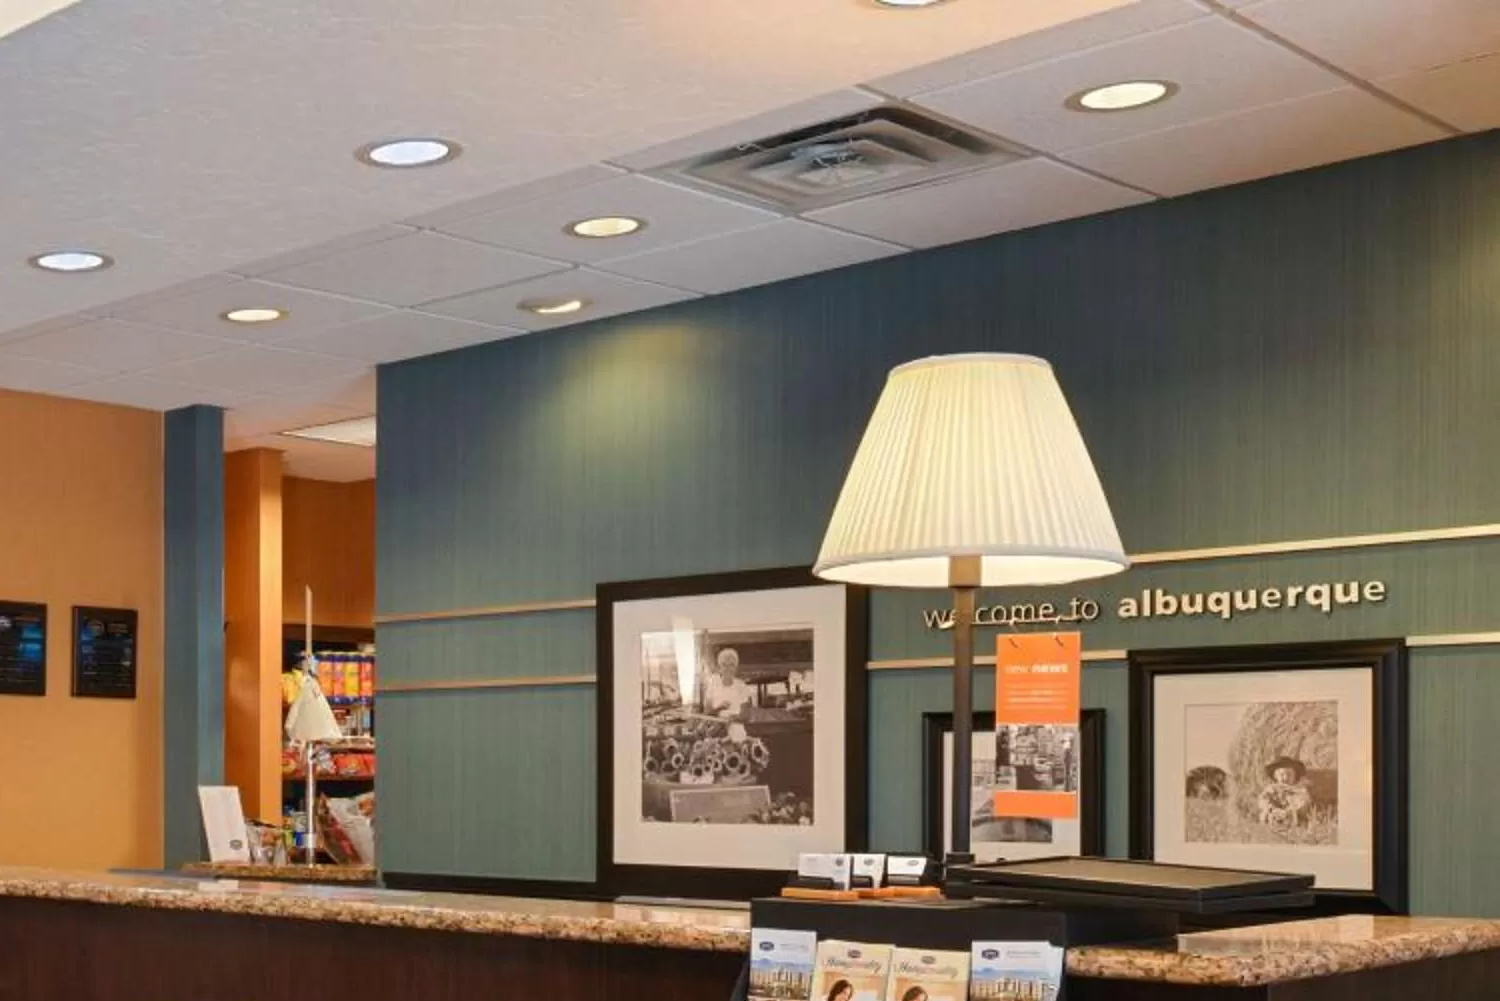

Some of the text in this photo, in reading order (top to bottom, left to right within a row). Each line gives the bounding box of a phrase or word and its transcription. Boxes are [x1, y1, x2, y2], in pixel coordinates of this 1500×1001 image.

[923, 580, 1386, 628] wecome to albuquerque
